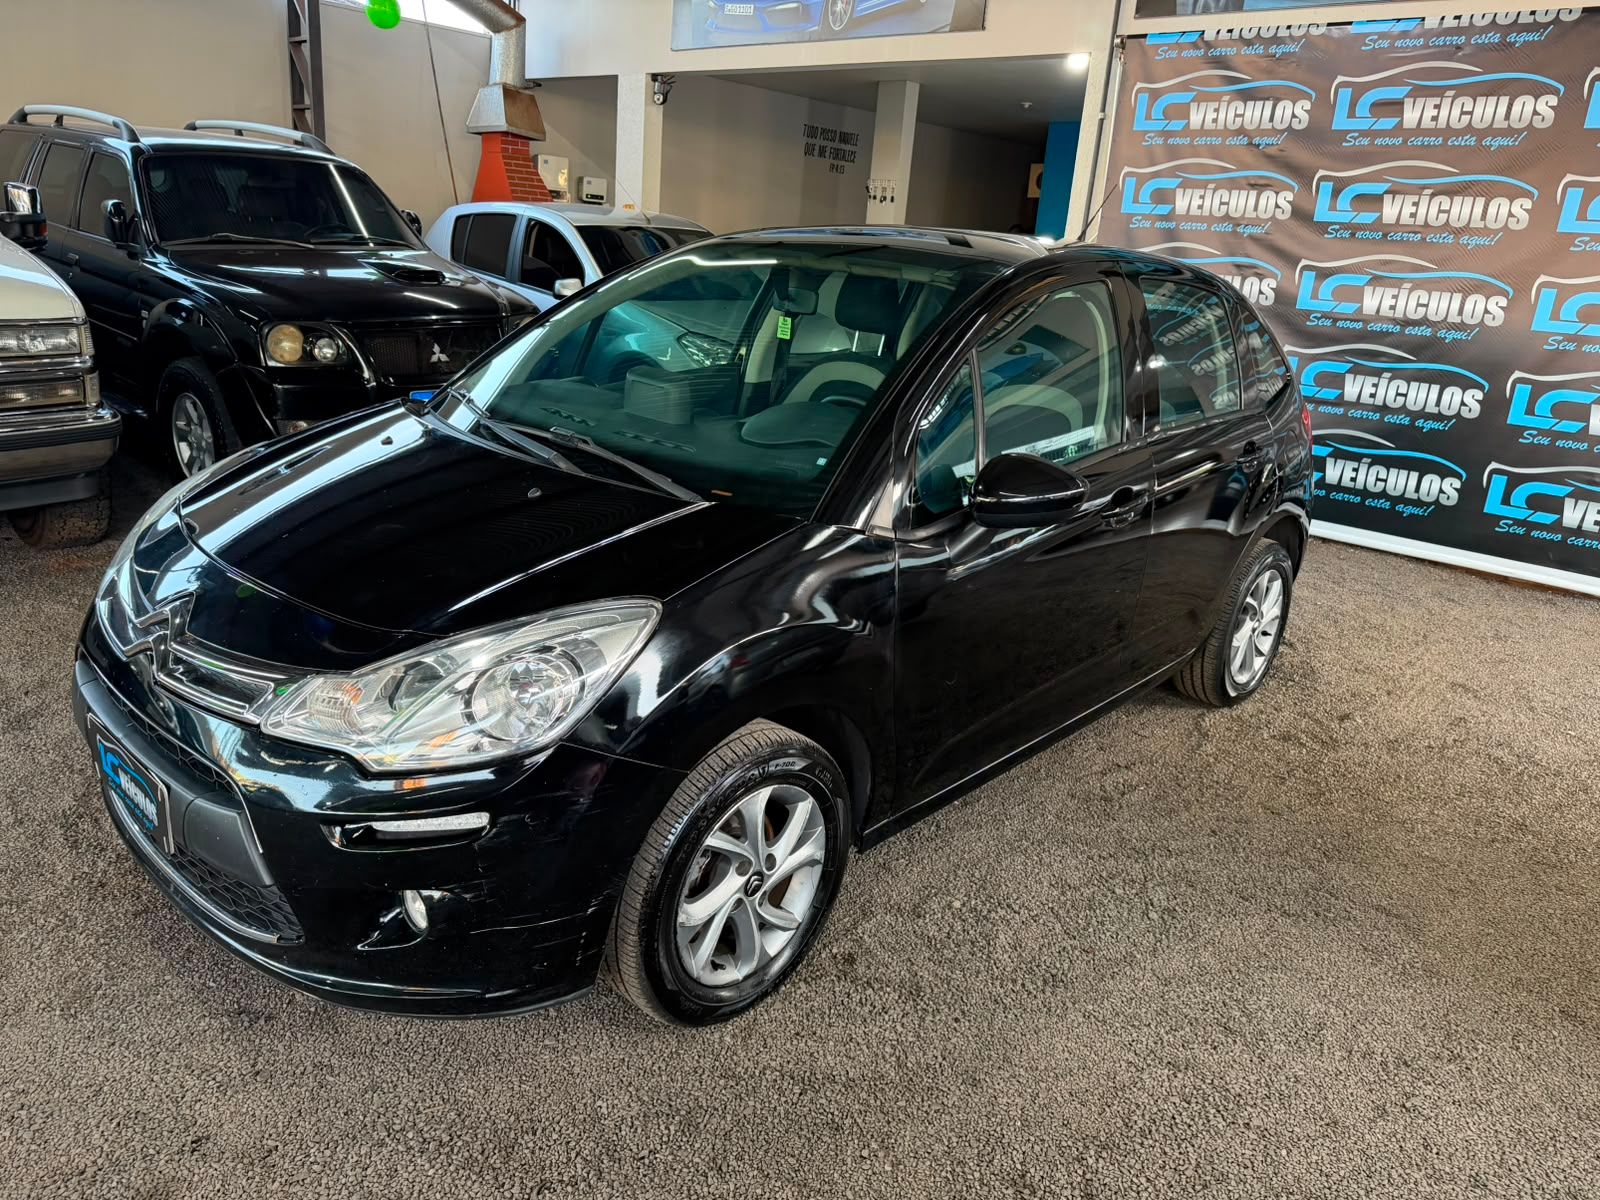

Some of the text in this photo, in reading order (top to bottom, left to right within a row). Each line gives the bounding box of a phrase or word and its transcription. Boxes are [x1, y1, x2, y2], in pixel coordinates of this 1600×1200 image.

[1155, 46, 1177, 60] Seu
[1181, 48, 1204, 57] novo
[1208, 46, 1237, 57] carro
[1269, 38, 1306, 57] aqui!
[1361, 36, 1390, 50] Seu
[1395, 37, 1424, 47] novo
[1429, 35, 1465, 46] carro
[1507, 25, 1554, 48] aqui!
[1133, 92, 1312, 131] LC VEÍCULOS
[1331, 86, 1413, 130] LC
[1403, 90, 1559, 129] VEÍCULOS
[803, 123, 819, 139] TUDO
[820, 127, 838, 143] POSSO
[1142, 133, 1164, 146] Seu
[1168, 136, 1190, 145] novo
[1194, 136, 1222, 145] carro
[1252, 132, 1288, 149] aqui!
[1342, 132, 1371, 147] Seu
[1375, 135, 1403, 146] novo
[1408, 135, 1443, 146] carro
[1482, 131, 1527, 150] aqui!
[804, 142, 816, 157] QUE
[1120, 177, 1294, 220] LC VEÍCULOS
[1313, 182, 1533, 230] LC VEÍCULOS
[1129, 216, 1151, 229] Seu
[1154, 220, 1176, 229] novo
[1179, 221, 1207, 231] carro
[1237, 221, 1272, 237] aqui!
[1324, 225, 1351, 239] Seu
[1355, 229, 1383, 240] novo
[1387, 231, 1422, 242] carro
[1459, 232, 1503, 250] aqui!
[1296, 271, 1373, 314] LC
[1362, 283, 1508, 327] VEÍCULOS
[1306, 313, 1332, 326] Seu
[1336, 320, 1363, 329] novo
[1367, 322, 1400, 333] carro
[1437, 328, 1479, 343] aqui!
[1543, 336, 1577, 351] Seu
[1343, 372, 1484, 419] VEÍCULOS
[1507, 384, 1600, 433] LC
[1318, 405, 1344, 415] novo
[1348, 408, 1380, 421] carro
[1415, 418, 1456, 432] aqui!
[1518, 430, 1552, 445] Seu
[1555, 439, 1589, 451] novo
[1325, 458, 1462, 506] VEÍCULOS
[1330, 491, 1361, 503] carro
[1395, 504, 1435, 517] aqui!
[1483, 474, 1576, 525] LC
[1494, 520, 1600, 549] Seu novo carr
